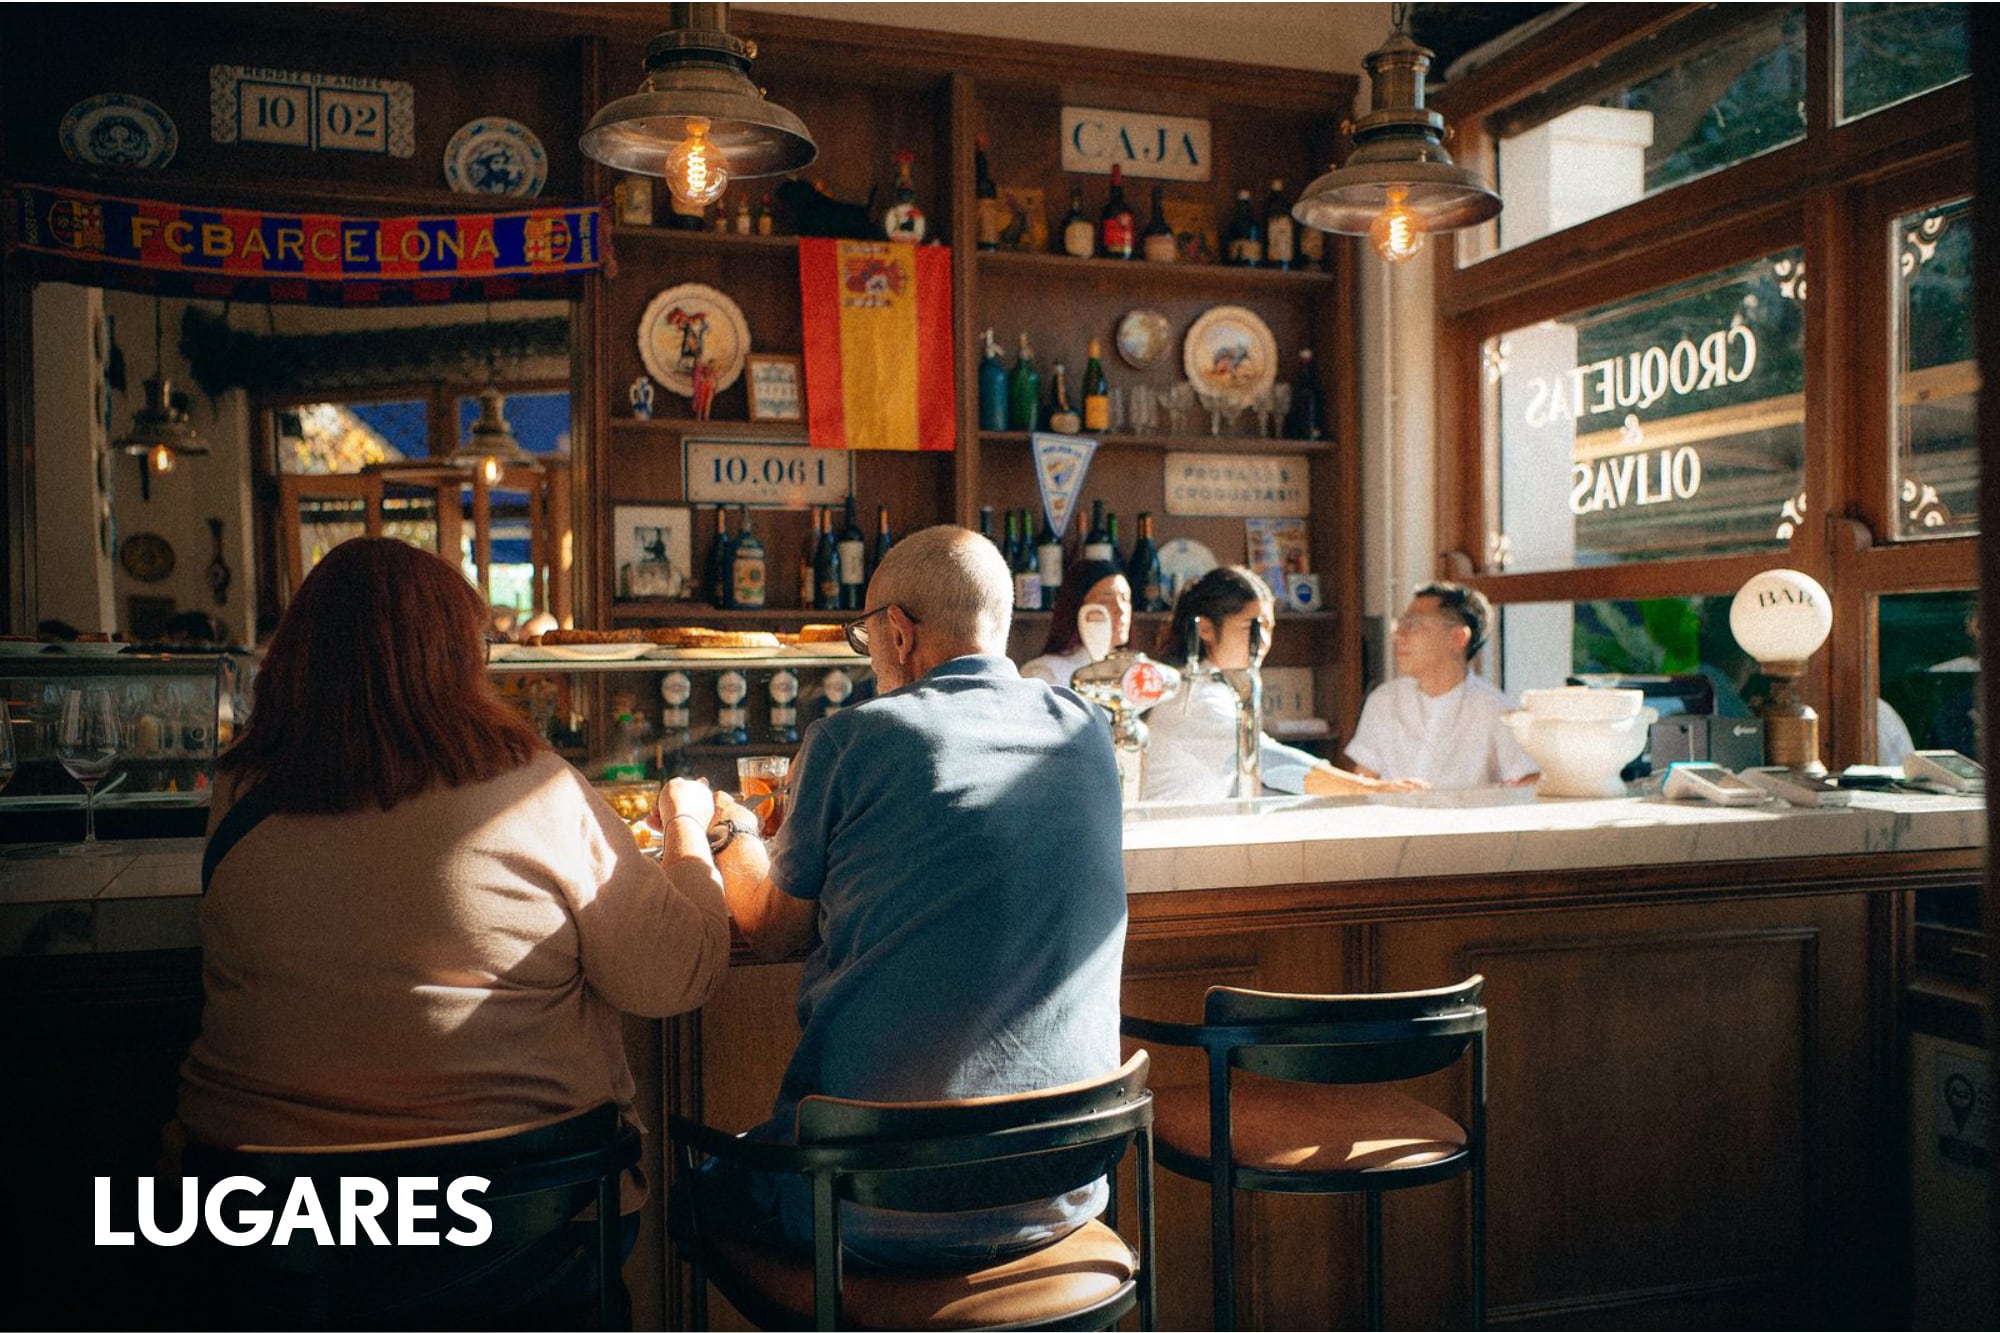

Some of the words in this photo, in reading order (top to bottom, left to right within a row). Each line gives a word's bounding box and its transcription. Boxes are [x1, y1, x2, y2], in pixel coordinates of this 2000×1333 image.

[257, 96, 295, 128] 10
[327, 102, 377, 137] 02
[1073, 120, 1199, 165] CAJA
[713, 457, 824, 486] 10.061
[1758, 587, 1815, 608] BAR
